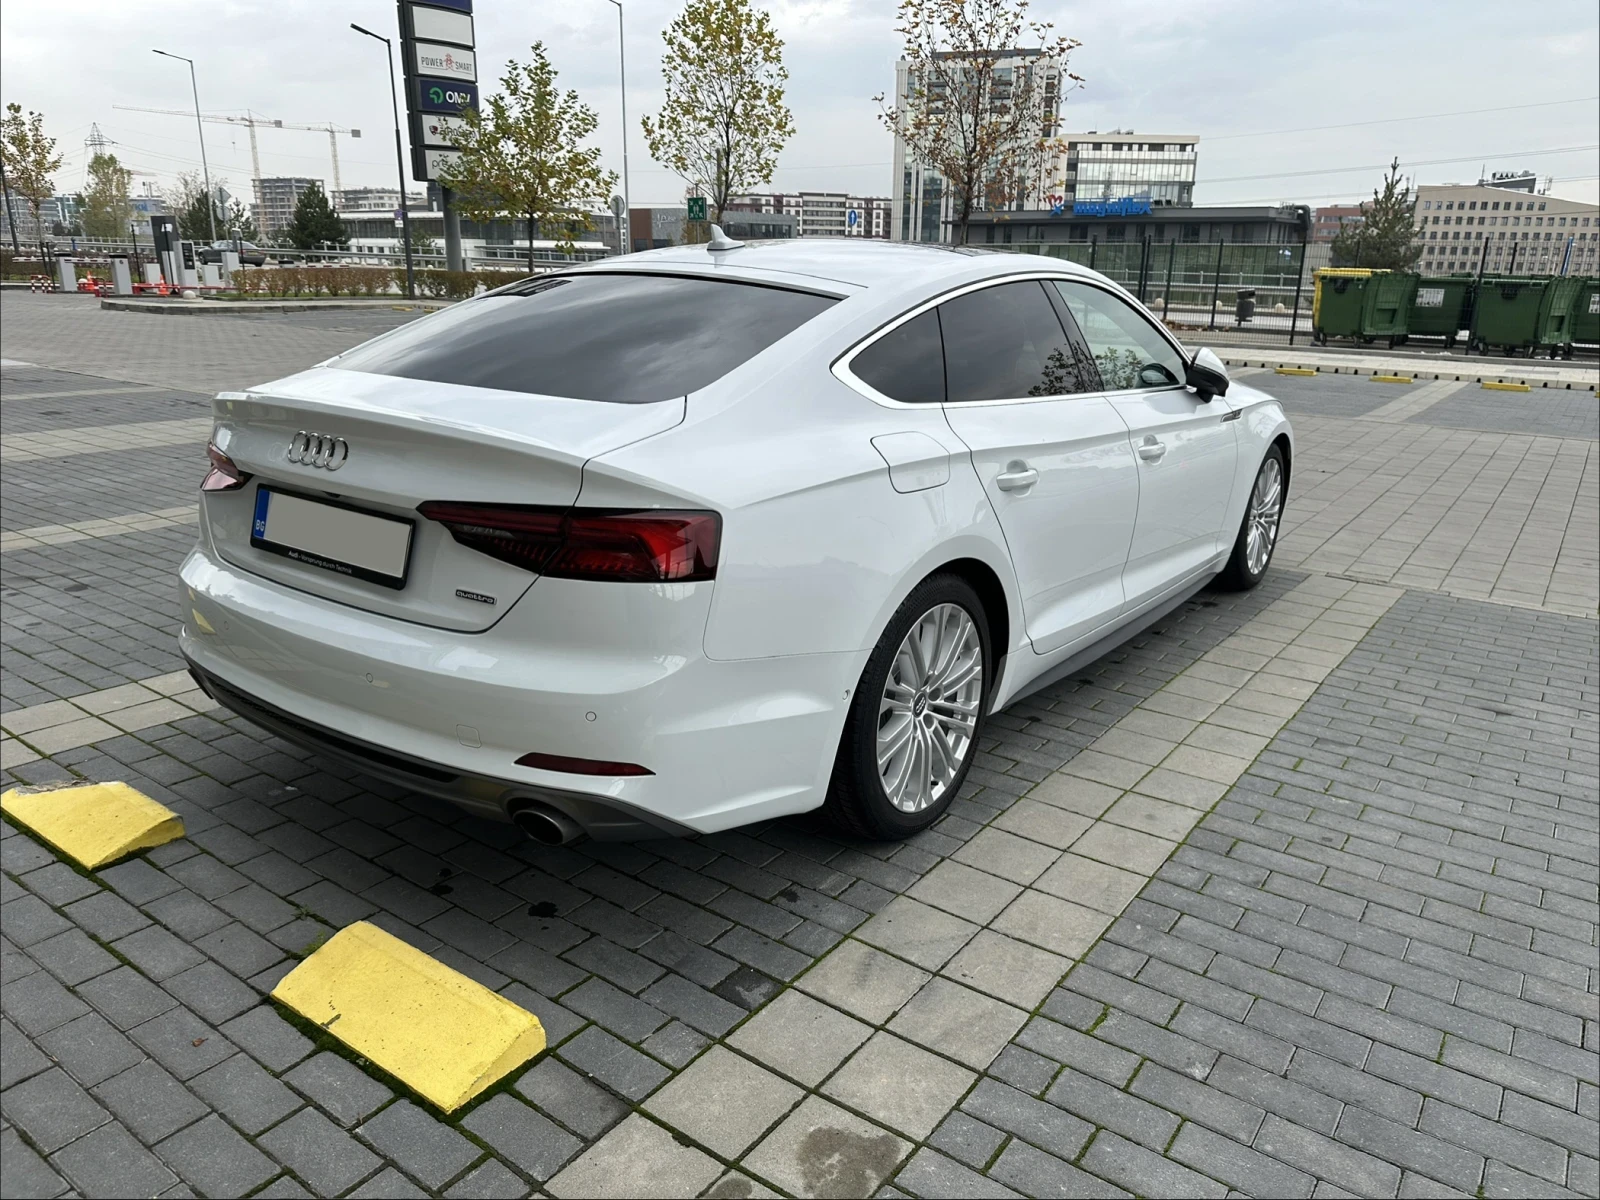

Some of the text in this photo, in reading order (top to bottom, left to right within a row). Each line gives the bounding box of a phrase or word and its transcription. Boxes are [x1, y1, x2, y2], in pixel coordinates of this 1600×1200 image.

[421, 56, 472, 72] POWER SMART
[1074, 197, 1152, 217] magniflex
[256, 520, 265, 532] BG
[288, 550, 298, 558] Audi
[301, 554, 322, 566] Vorsprung
[322, 561, 336, 569] durch
[336, 564, 352, 574] Technik
[457, 590, 494, 603] quattro
